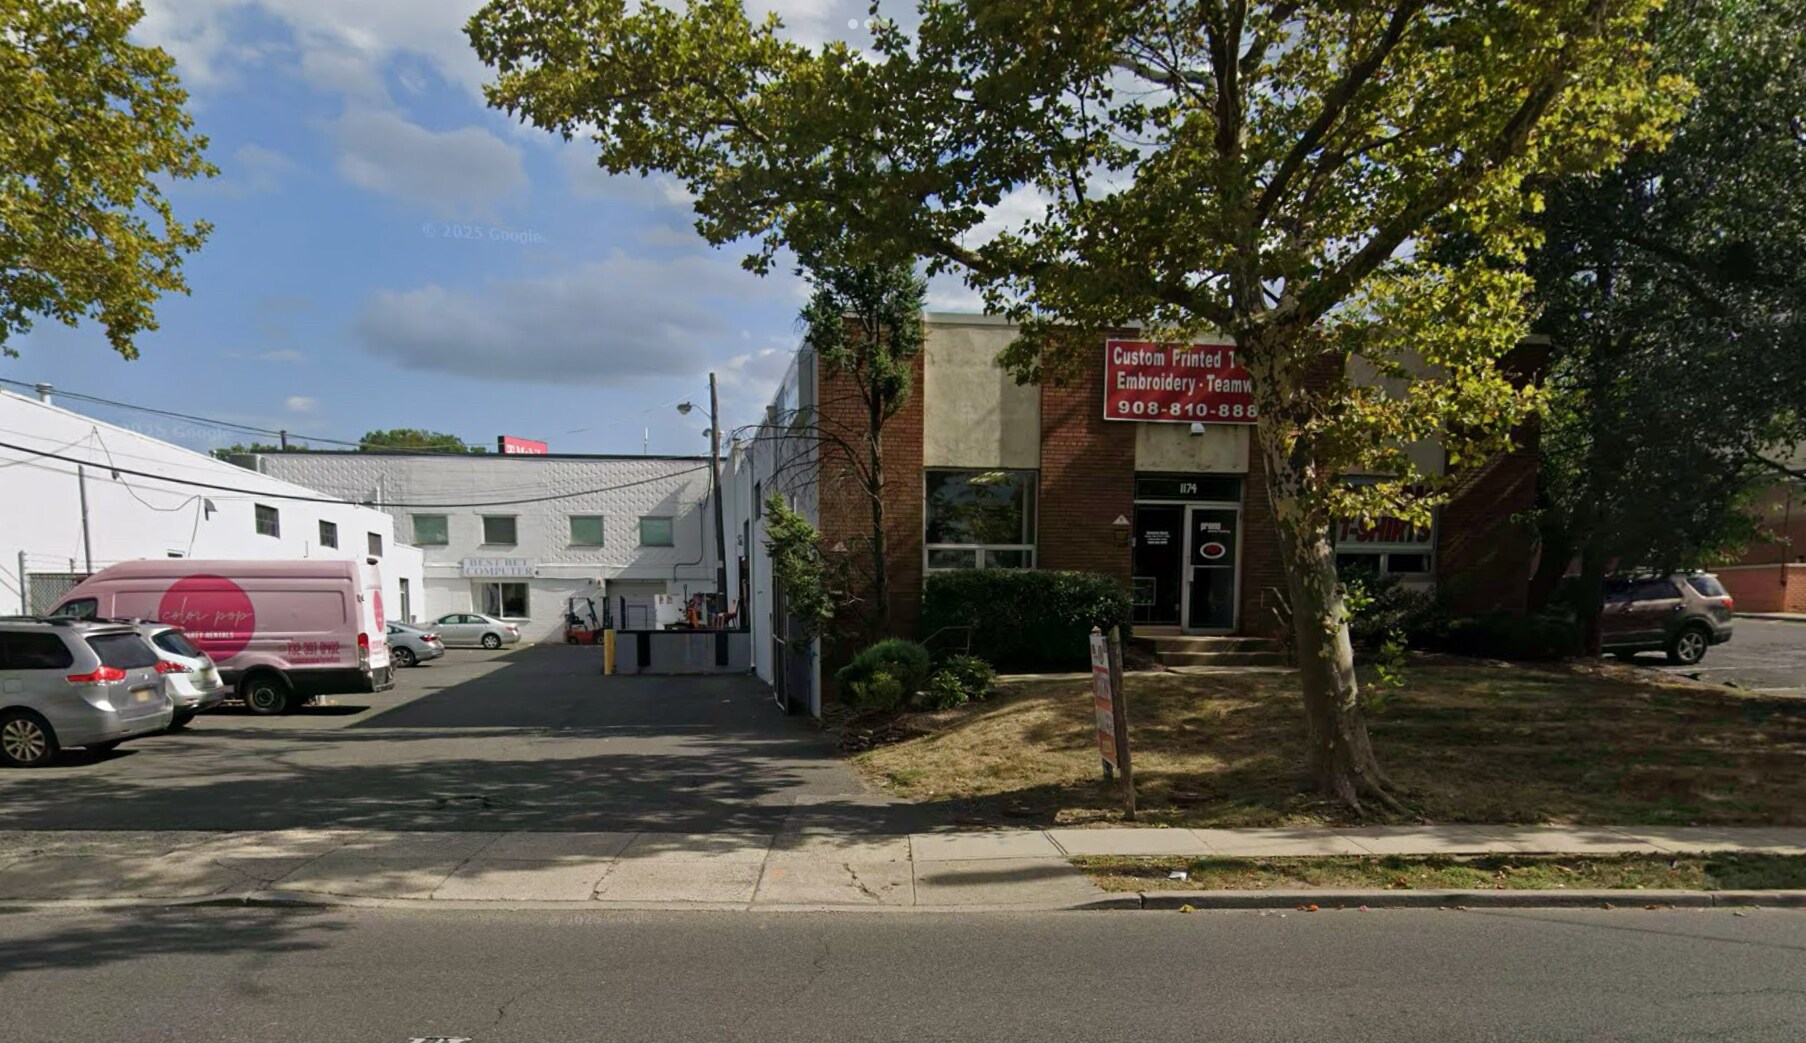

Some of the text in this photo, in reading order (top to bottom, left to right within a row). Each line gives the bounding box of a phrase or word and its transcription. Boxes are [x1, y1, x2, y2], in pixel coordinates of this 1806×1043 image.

[1113, 346, 1165, 367] Custom
[1172, 349, 1221, 369] Printed
[1117, 371, 1196, 396] Embroidery
[1180, 483, 1197, 494] 1174
[469, 558, 528, 567] BEST BET
[466, 567, 534, 576] COMPUTER
[161, 596, 254, 628] color pop
